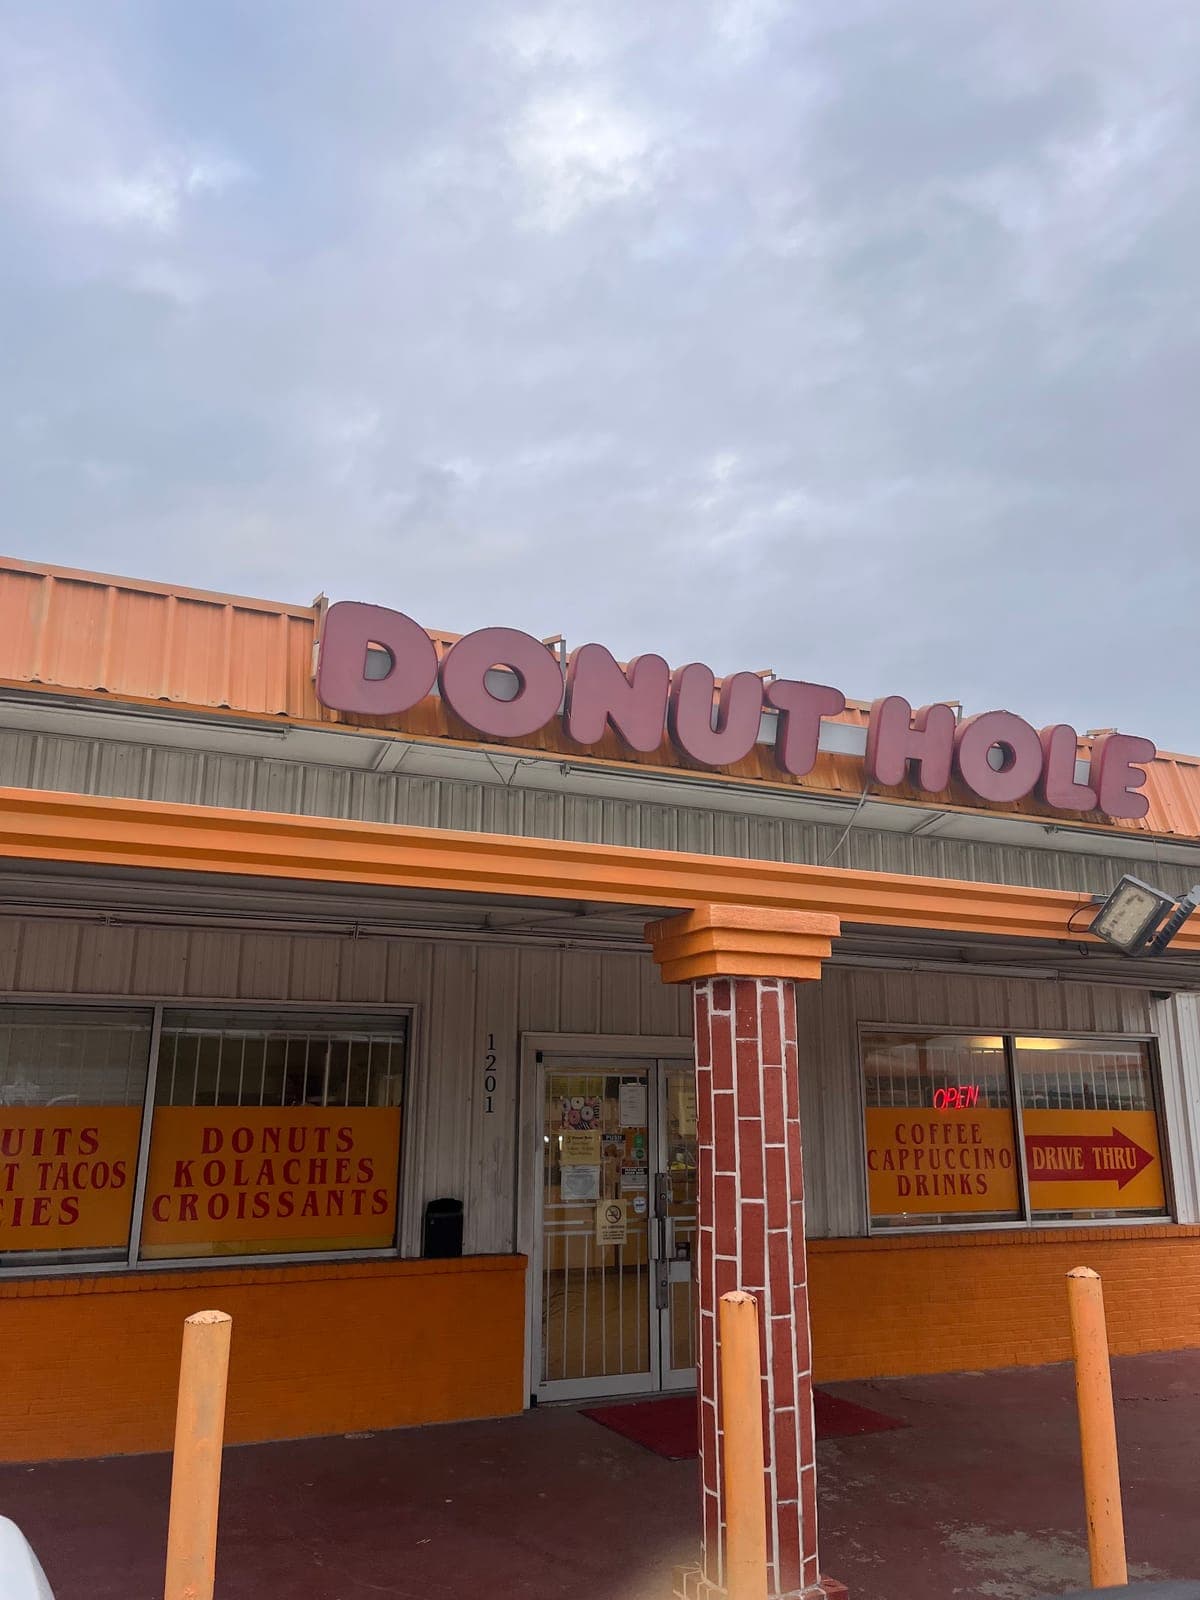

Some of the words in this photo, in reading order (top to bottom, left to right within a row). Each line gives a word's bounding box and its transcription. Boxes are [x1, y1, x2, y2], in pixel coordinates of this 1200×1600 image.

[316, 600, 845, 777] DONUT
[865, 695, 1157, 819] HOLE
[484, 1033, 497, 1113] 1201
[933, 1085, 979, 1110] OPEN
[201, 1126, 354, 1154] DONUTS
[895, 1123, 982, 1145] COFFEE
[173, 1157, 375, 1188] KOLACHES
[867, 1147, 1012, 1171] CAPPUCCINO
[1032, 1146, 1085, 1170] DRIVE
[1092, 1147, 1137, 1170] THRU
[38, 1160, 127, 1191] TACOS
[897, 1173, 988, 1197] DRINKS
[0, 1196, 80, 1227] IES
[151, 1188, 389, 1222] CROISSANTS
